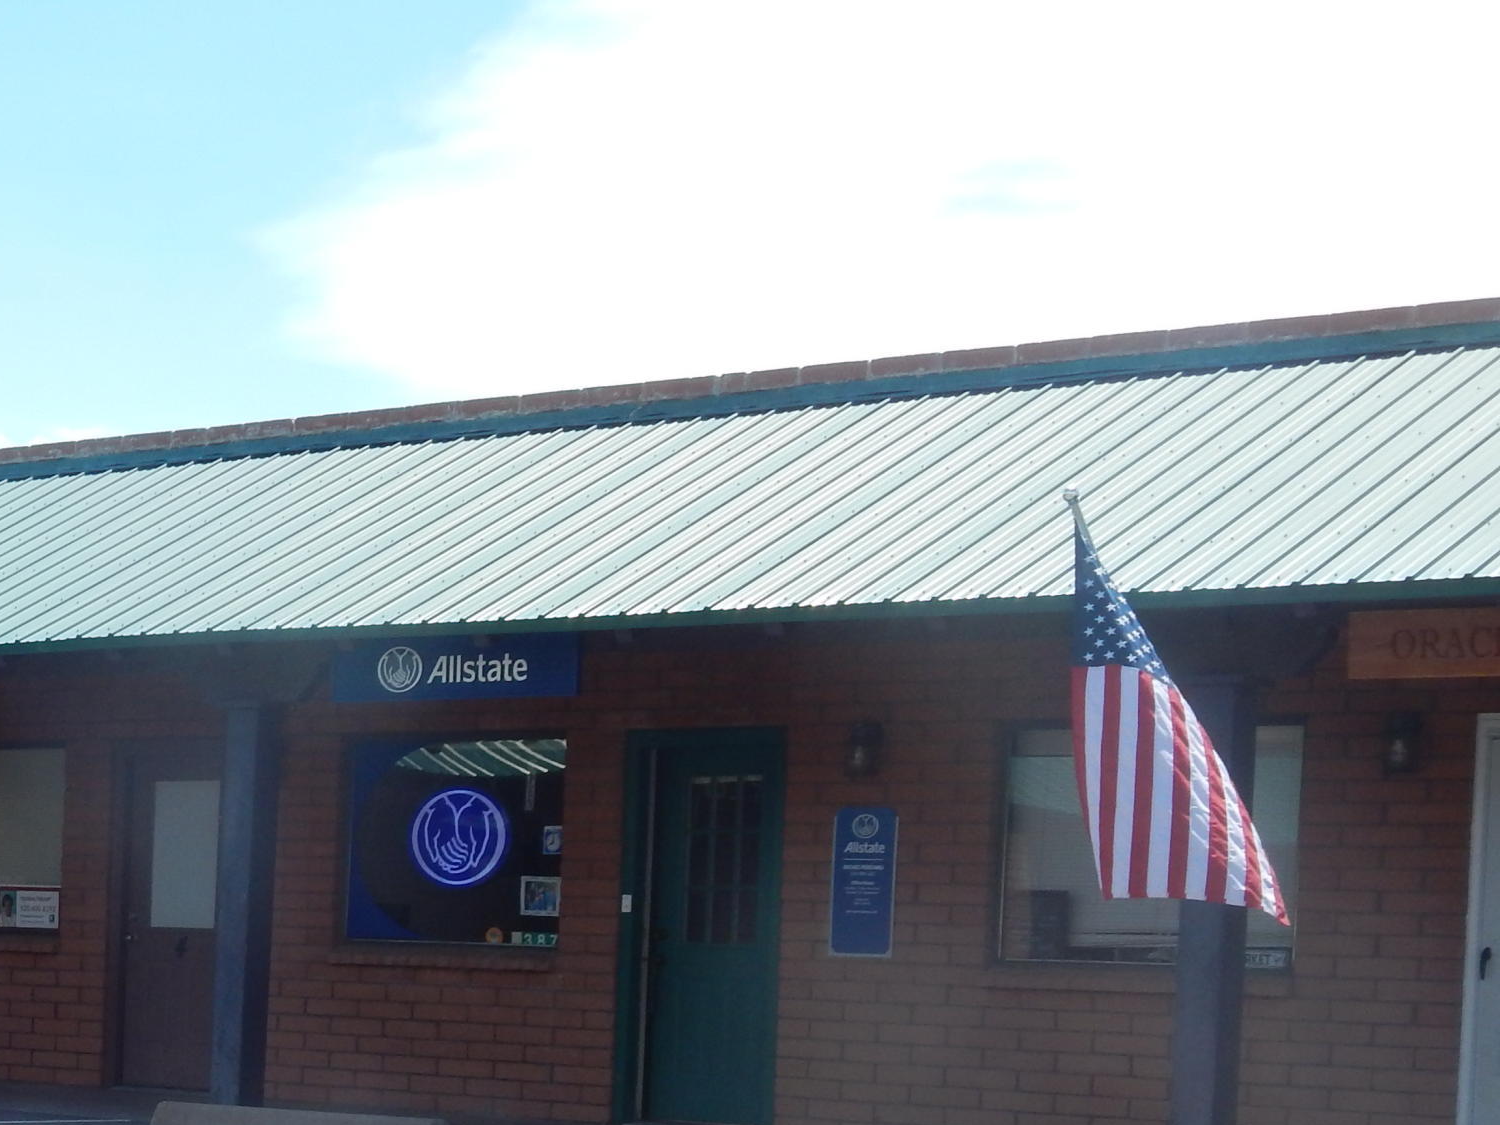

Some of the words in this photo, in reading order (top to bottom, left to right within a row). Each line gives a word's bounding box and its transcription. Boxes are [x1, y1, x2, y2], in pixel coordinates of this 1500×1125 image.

[426, 653, 528, 684] Allstate
[843, 841, 886, 854] Allstate
[523, 934, 558, 945] 387
